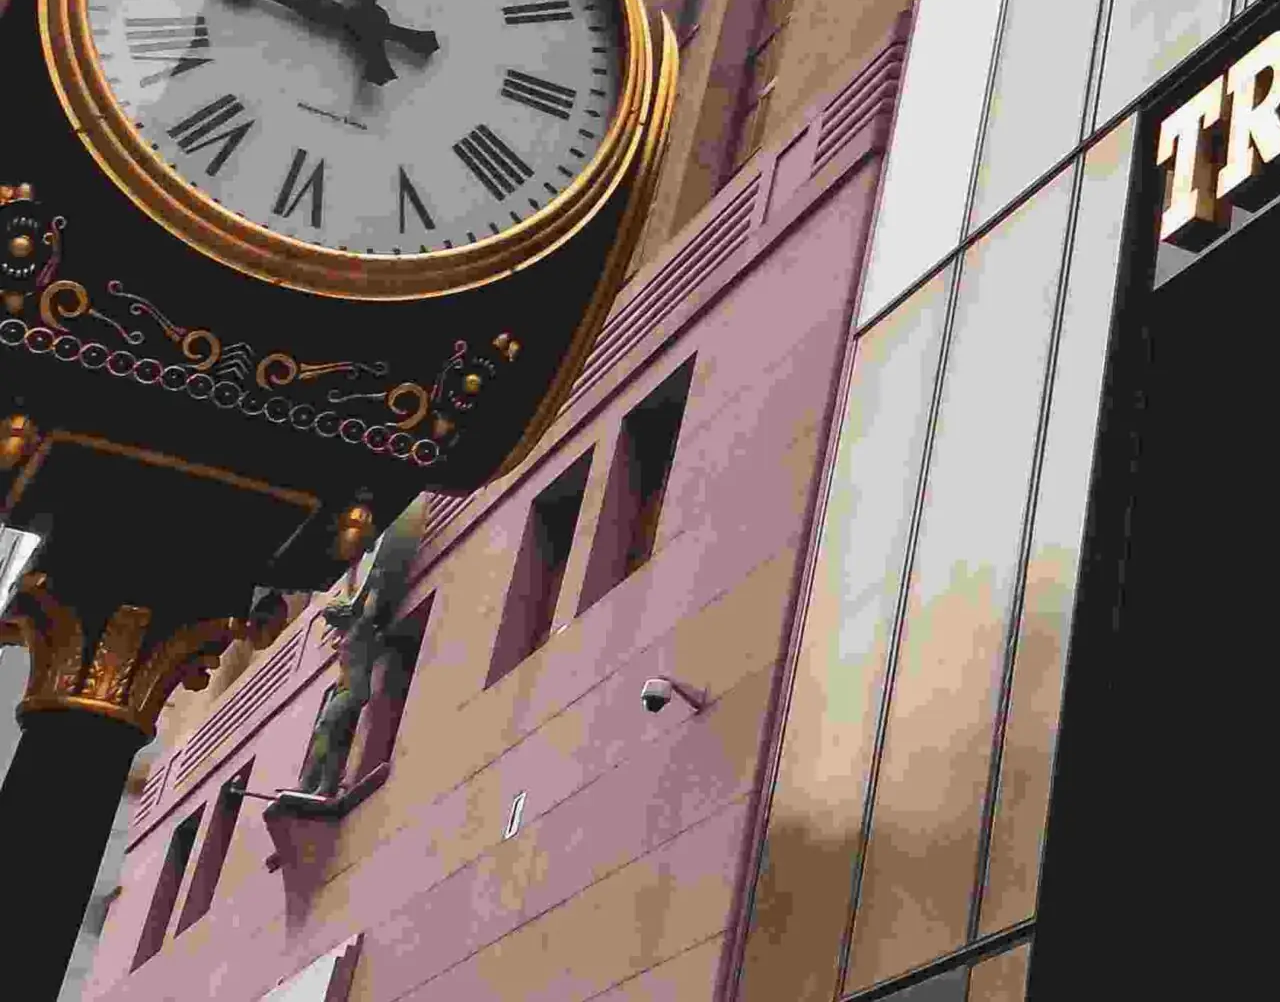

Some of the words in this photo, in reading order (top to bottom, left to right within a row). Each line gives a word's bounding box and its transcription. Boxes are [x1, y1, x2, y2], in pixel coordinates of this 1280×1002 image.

[167, 93, 256, 177] VII
[500, 69, 578, 120] III
[272, 147, 325, 229] VI
